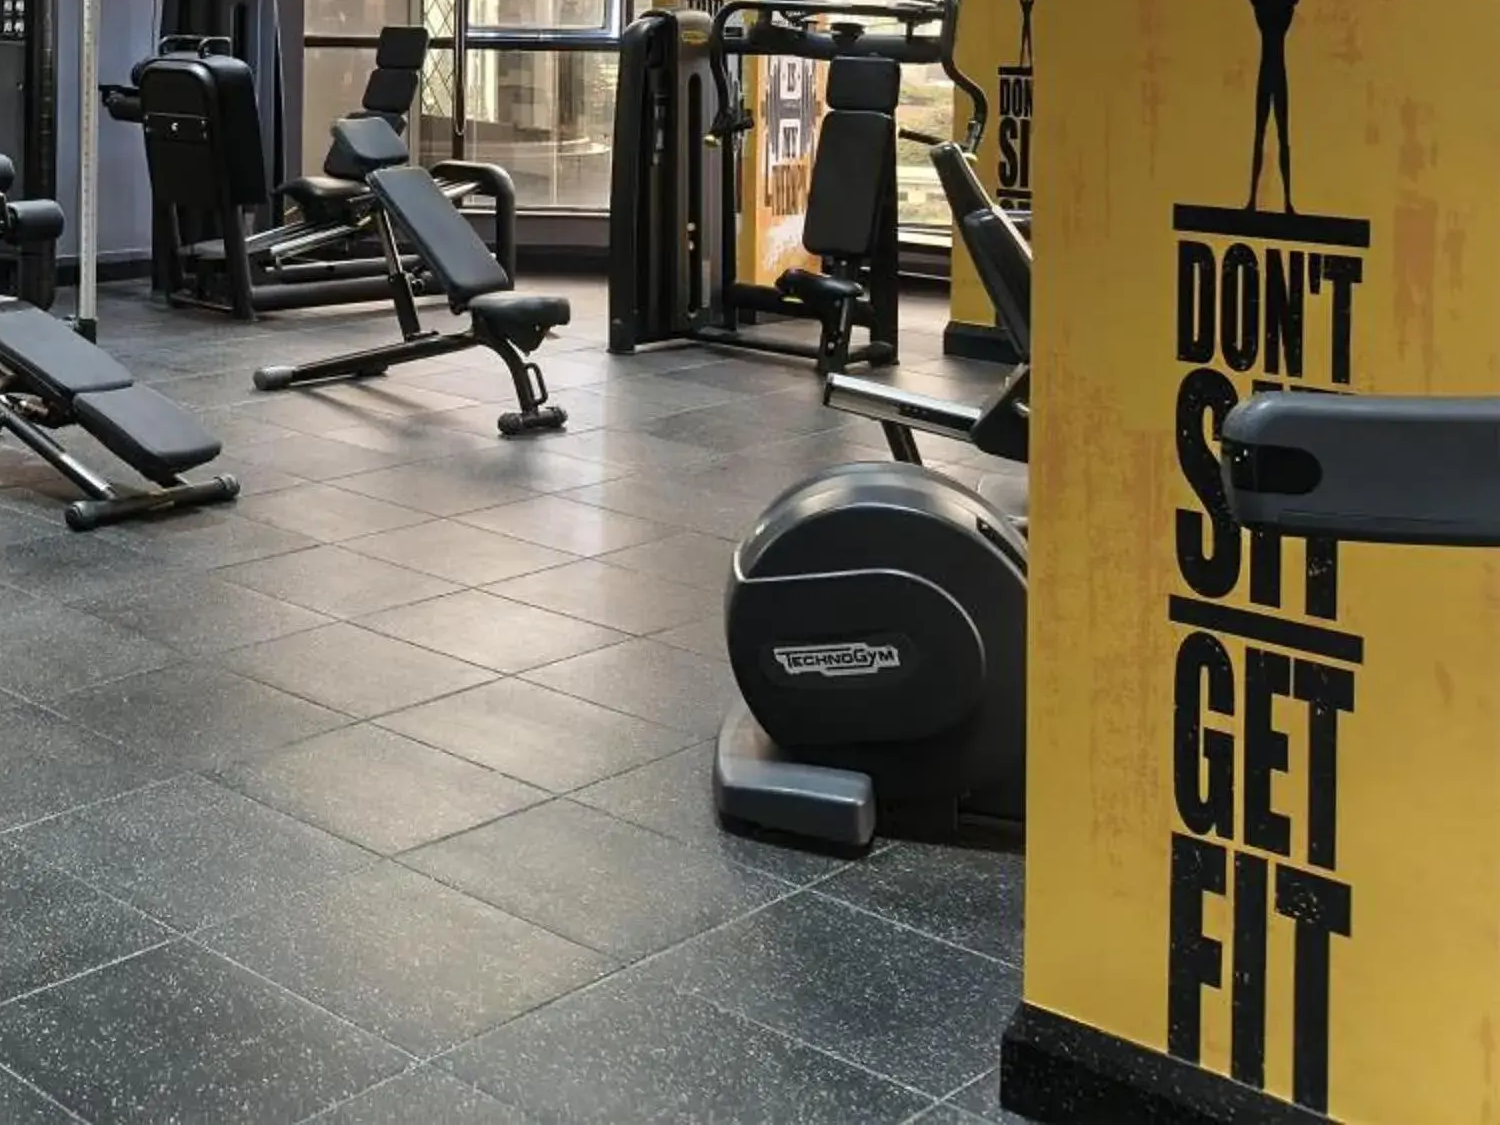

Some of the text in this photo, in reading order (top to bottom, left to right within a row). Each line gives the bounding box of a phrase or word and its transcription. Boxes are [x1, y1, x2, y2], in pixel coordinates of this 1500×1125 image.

[999, 116, 1031, 188] SI
[1175, 239, 1364, 385] DON'T
[1172, 631, 1355, 873] GET
[1168, 831, 1352, 1117] FIT
